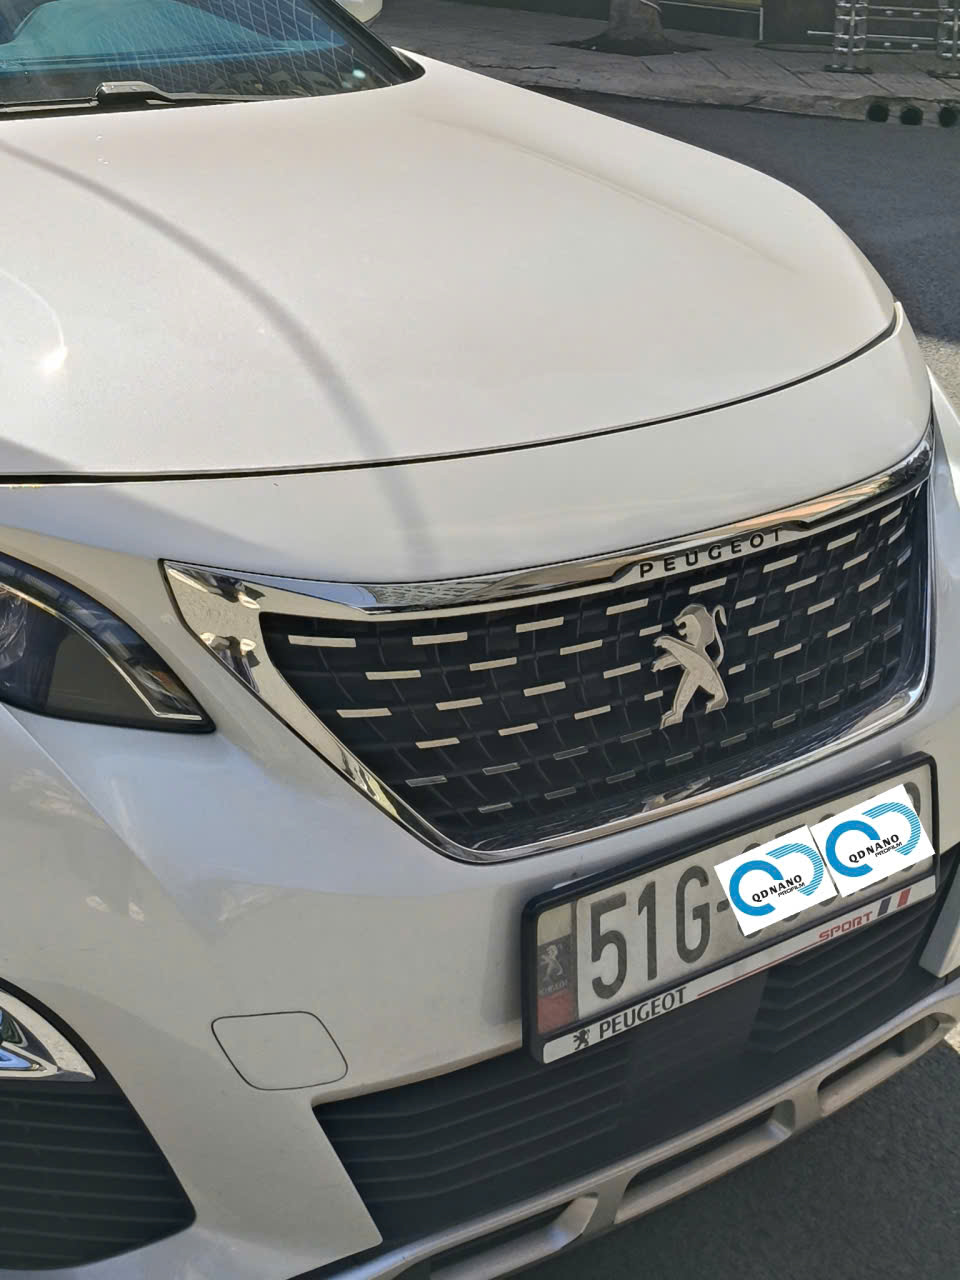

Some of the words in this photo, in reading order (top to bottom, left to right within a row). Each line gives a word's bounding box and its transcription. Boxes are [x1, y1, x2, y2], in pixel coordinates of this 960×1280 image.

[640, 528, 782, 578] PEUGEOT
[819, 911, 873, 940] SPORT
[600, 987, 687, 1039] PEUGEOT
